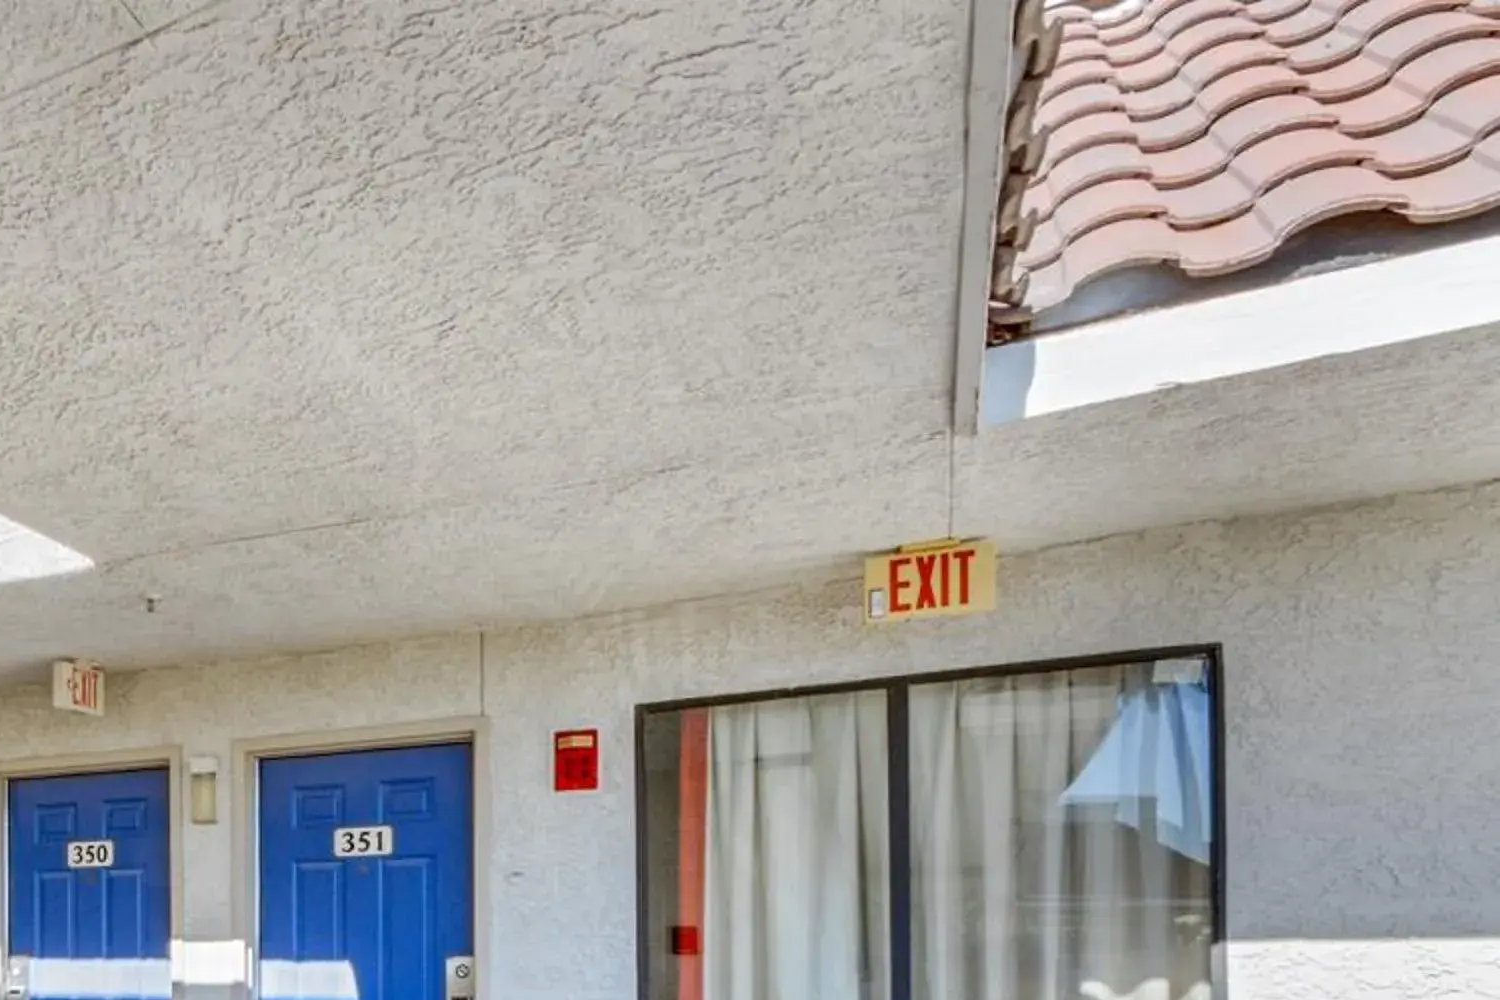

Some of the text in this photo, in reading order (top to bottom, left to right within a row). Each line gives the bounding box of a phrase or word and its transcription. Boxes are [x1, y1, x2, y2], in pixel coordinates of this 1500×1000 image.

[889, 550, 975, 613] EXIT
[341, 830, 384, 853] 351
[72, 844, 108, 865] 350
